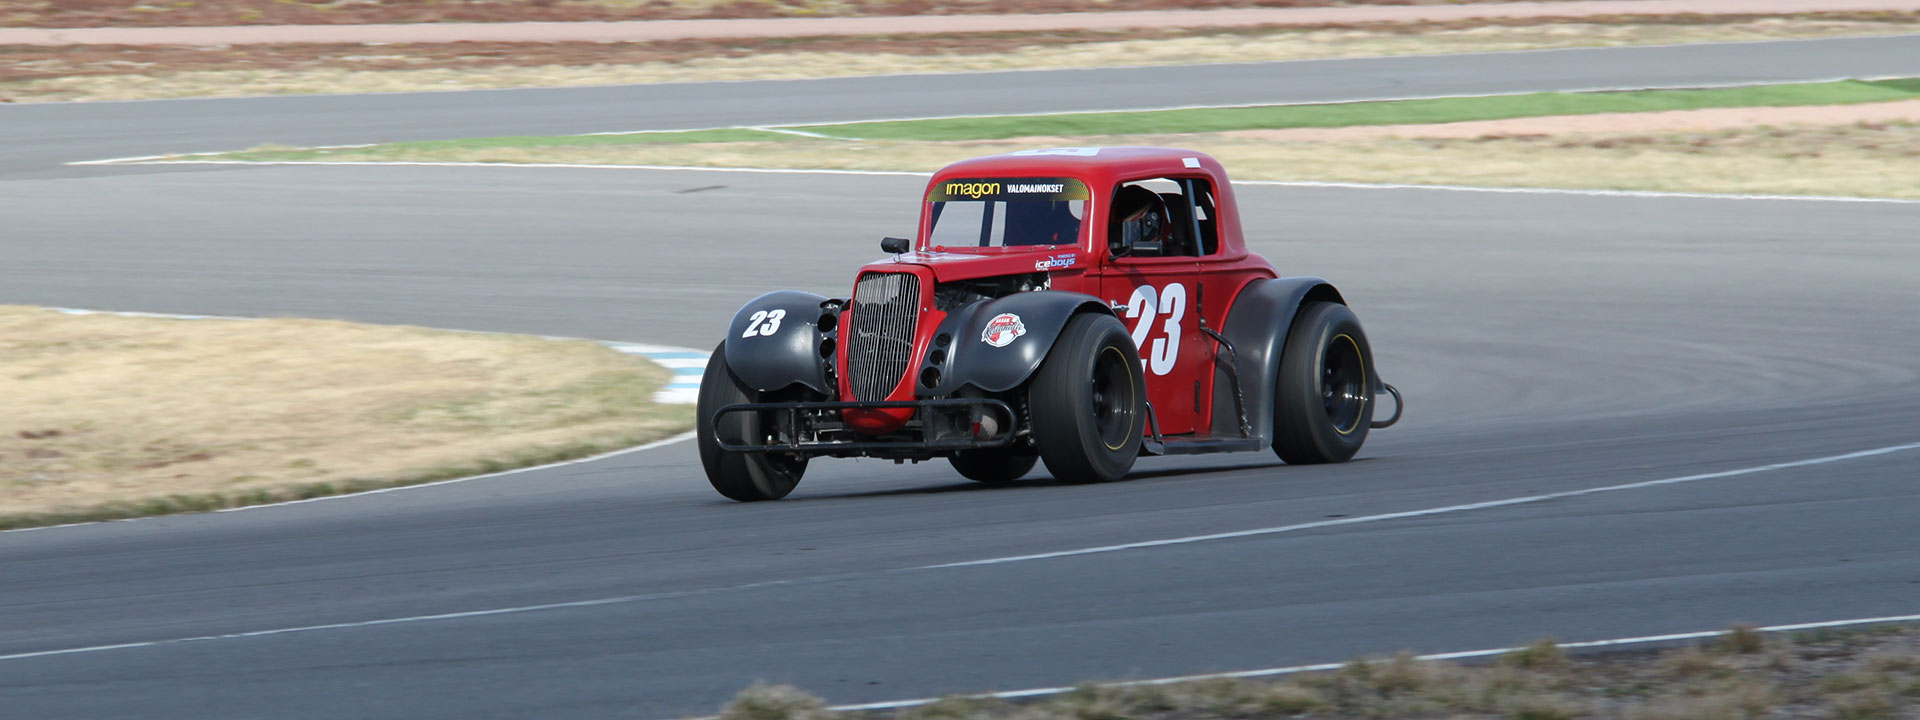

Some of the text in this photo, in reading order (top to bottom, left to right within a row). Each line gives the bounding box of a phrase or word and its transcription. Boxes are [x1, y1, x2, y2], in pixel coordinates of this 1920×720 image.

[1007, 184, 1063, 193] VALOMAINOKSET
[742, 309, 786, 338] 23
[1125, 282, 1187, 376] 23
